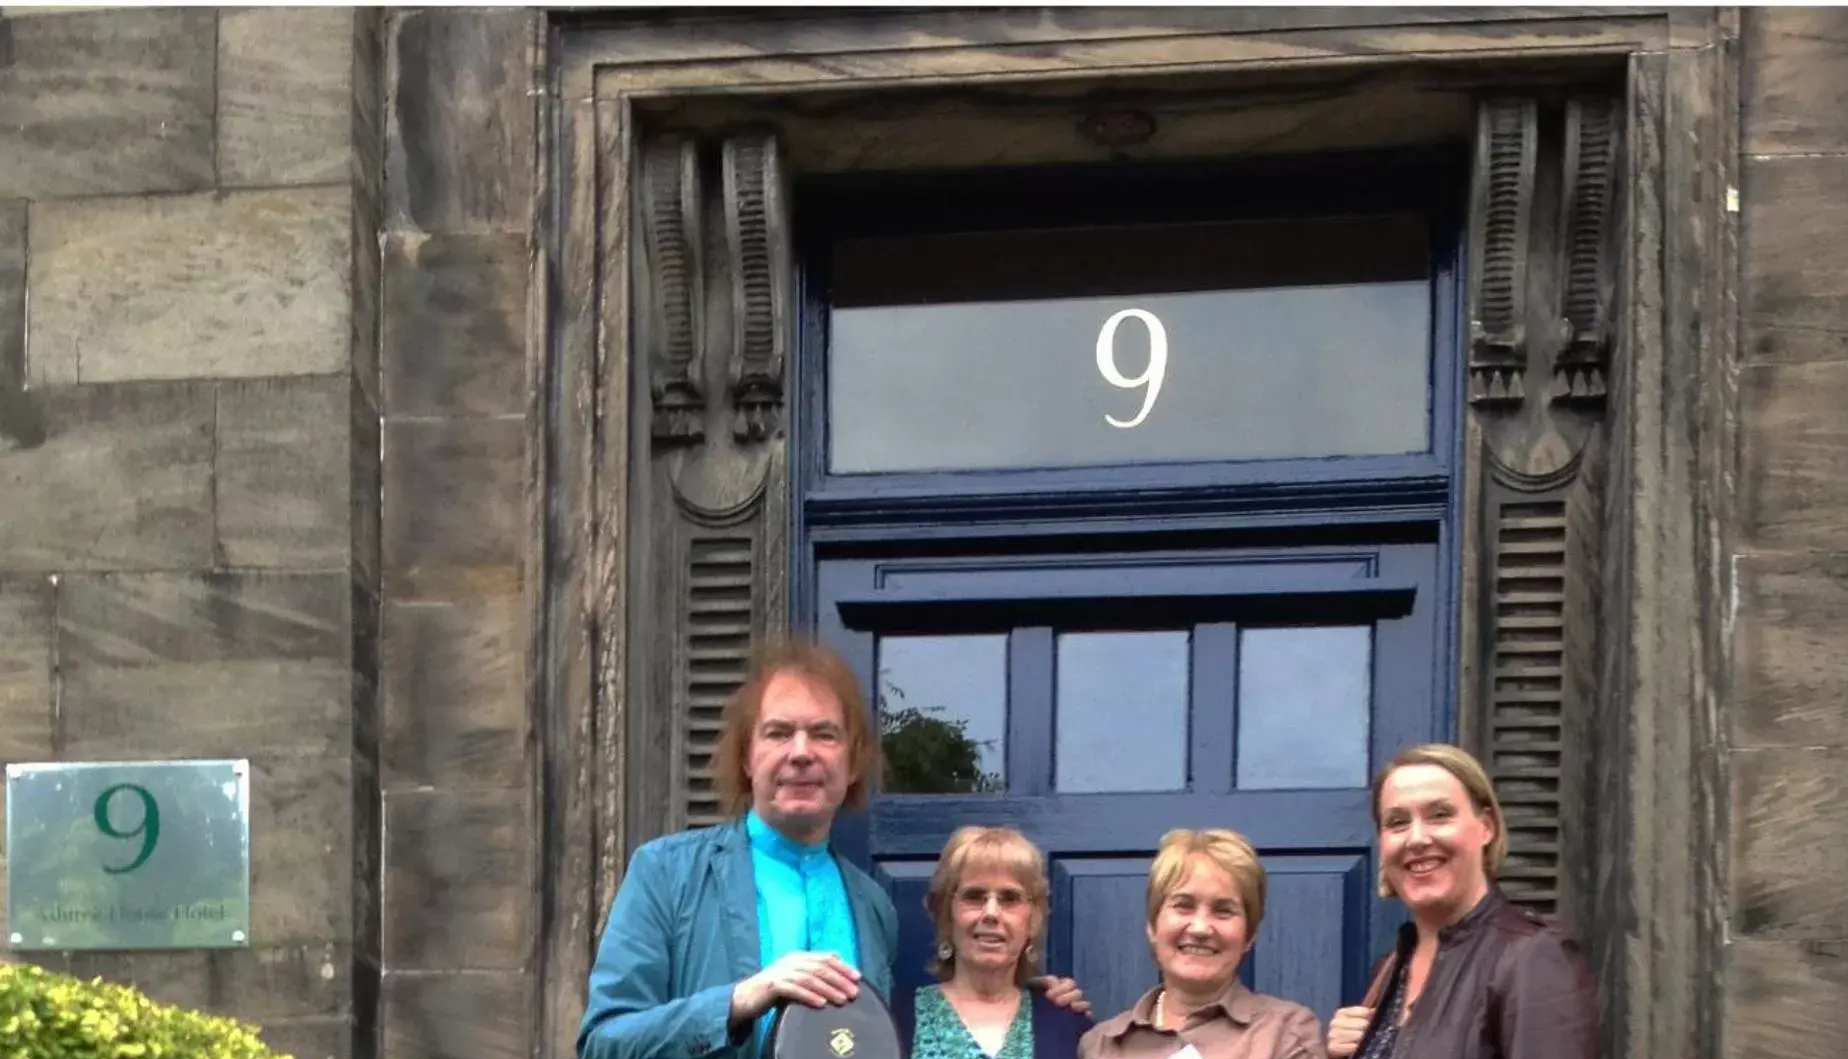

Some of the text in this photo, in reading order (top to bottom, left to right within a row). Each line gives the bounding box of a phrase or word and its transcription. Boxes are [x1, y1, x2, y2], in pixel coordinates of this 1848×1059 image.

[1096, 308, 1168, 428] 9
[94, 783, 160, 876] 9
[174, 903, 227, 922] Hotel
